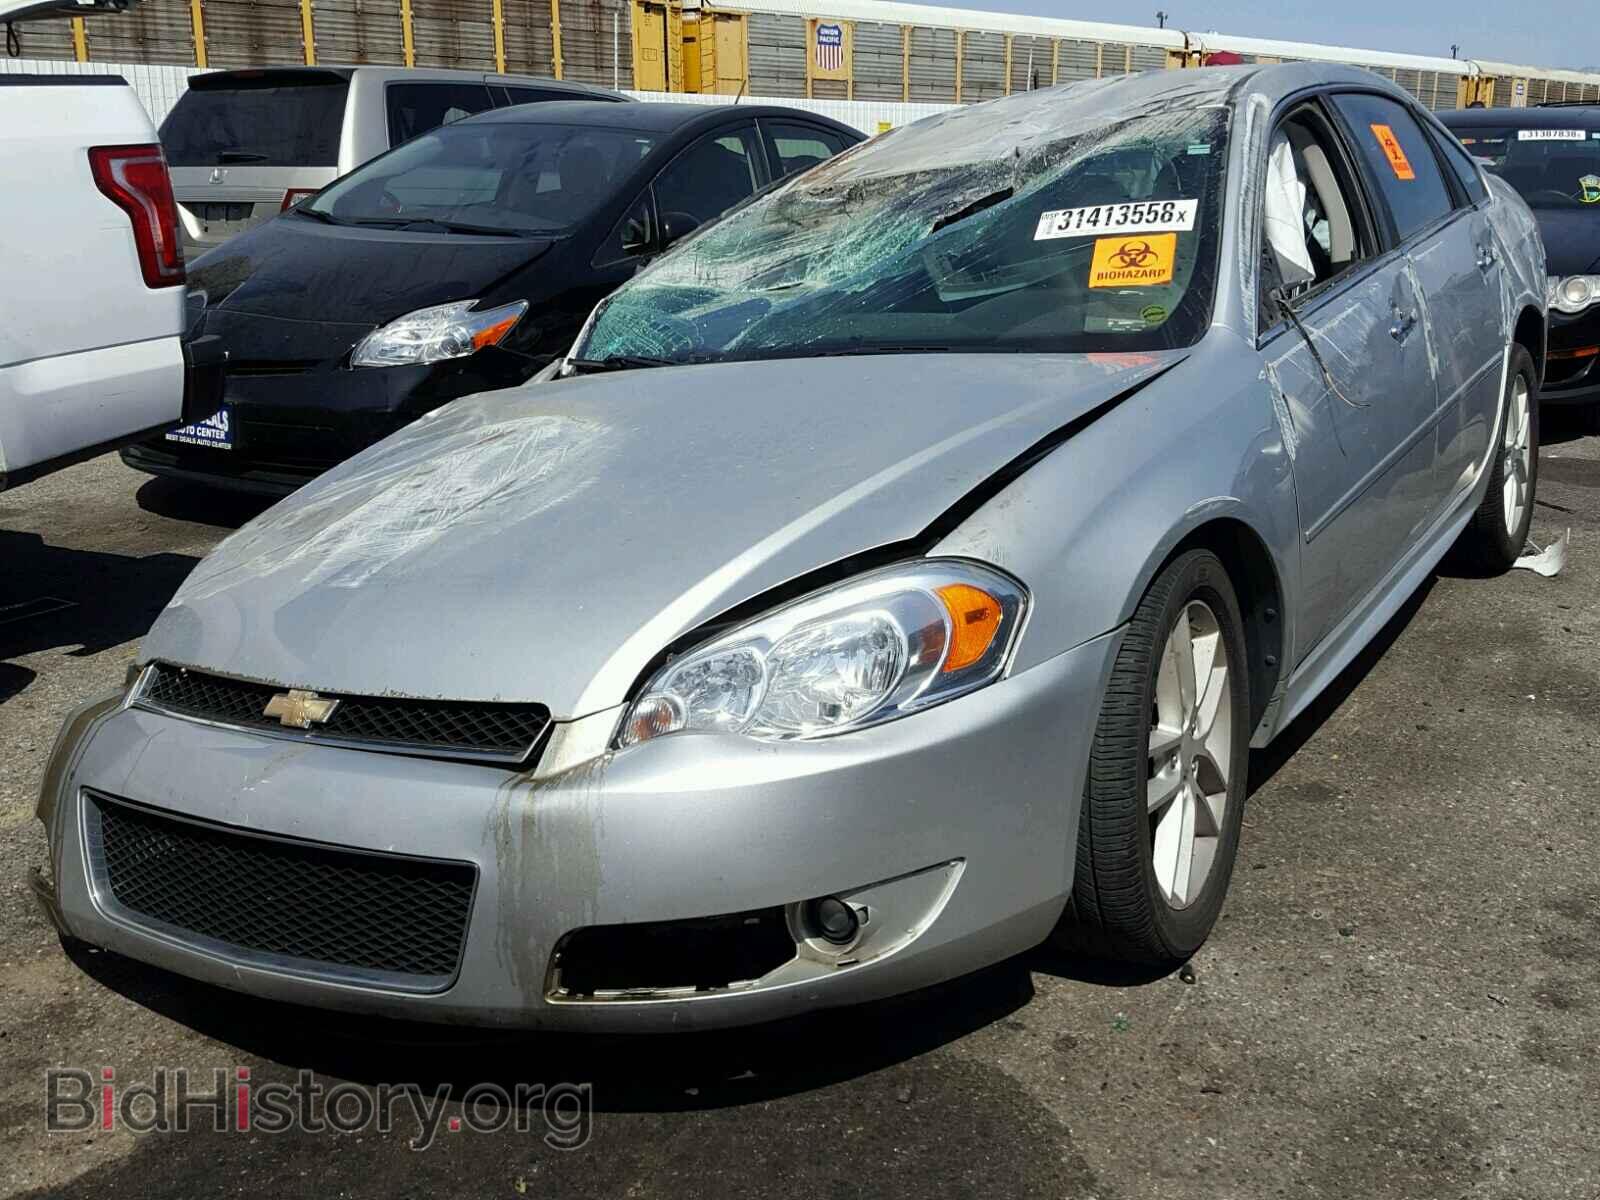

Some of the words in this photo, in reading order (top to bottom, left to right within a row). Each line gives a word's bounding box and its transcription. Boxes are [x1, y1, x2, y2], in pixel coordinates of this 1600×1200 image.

[819, 35, 841, 43] PACIFIC
[1057, 202, 1176, 231] 31413558
[1096, 268, 1166, 281] BIOHAZARD
[196, 427, 226, 440] CENTER
[197, 438, 211, 447] AUTO
